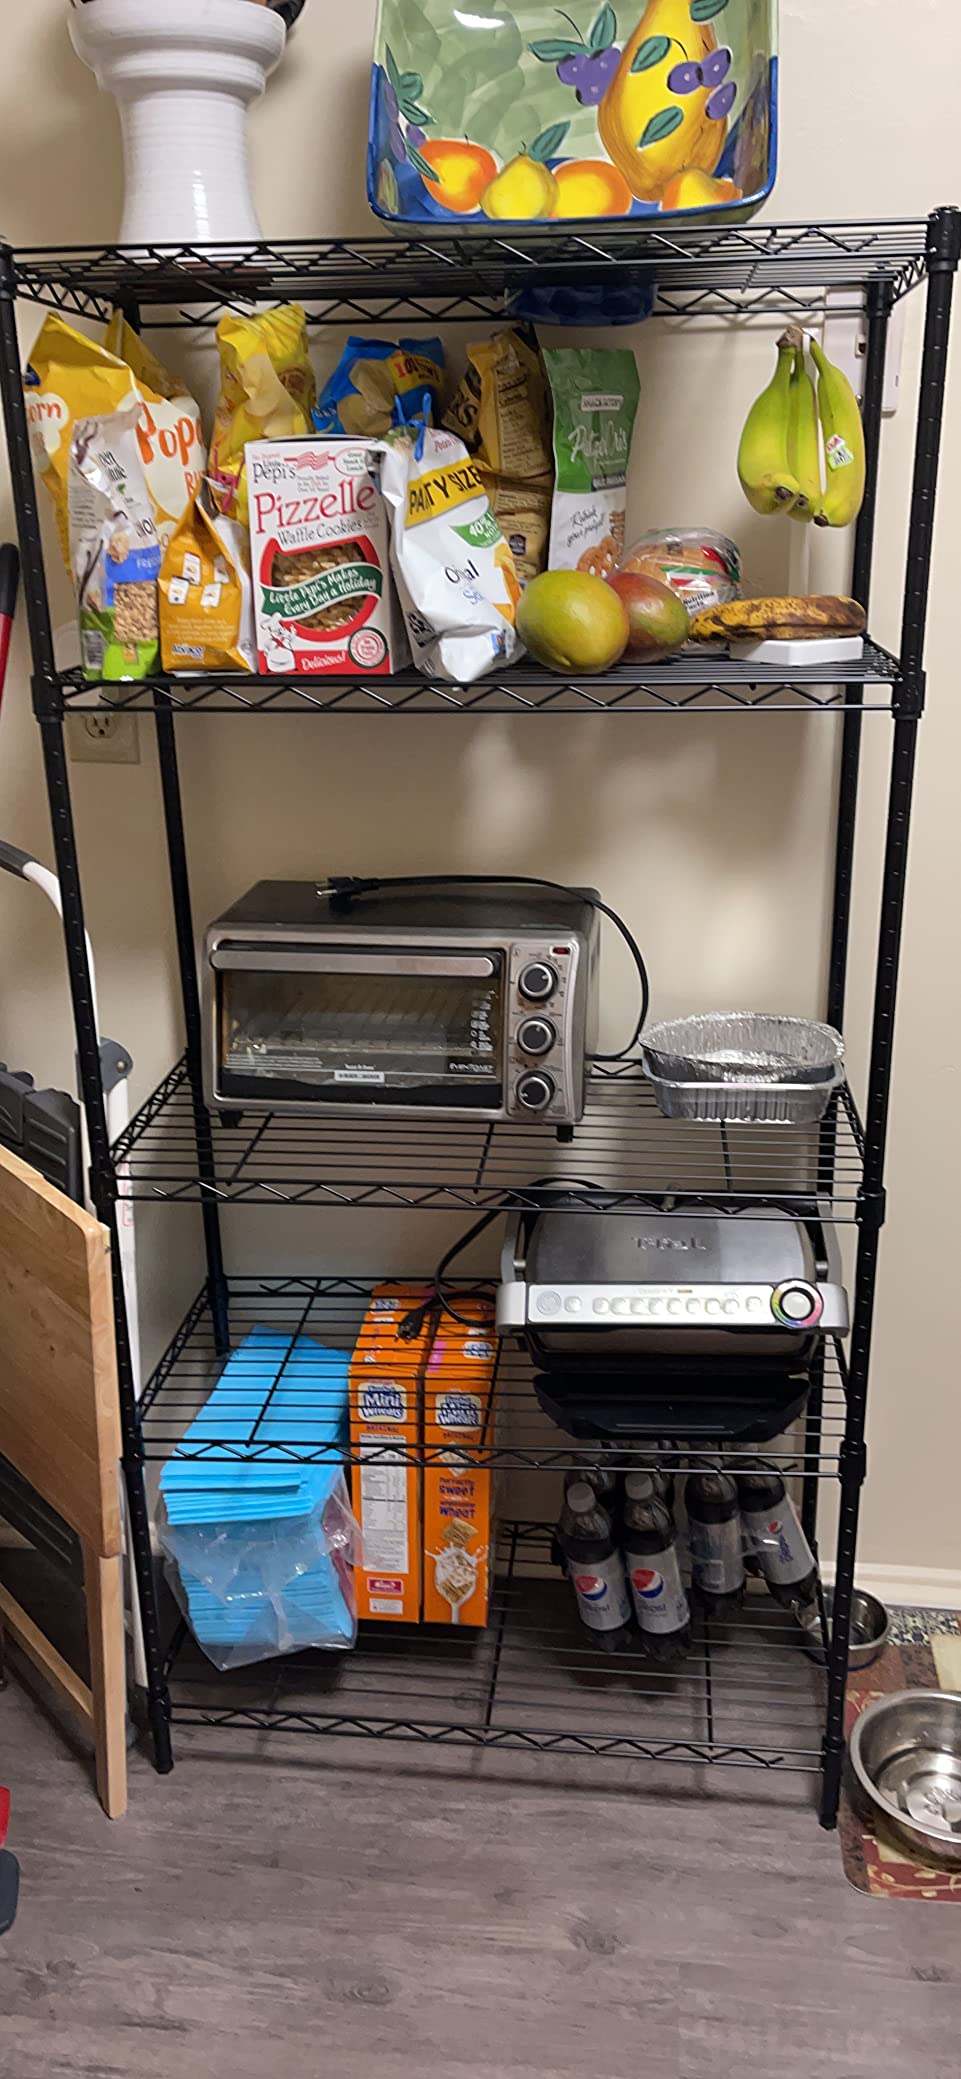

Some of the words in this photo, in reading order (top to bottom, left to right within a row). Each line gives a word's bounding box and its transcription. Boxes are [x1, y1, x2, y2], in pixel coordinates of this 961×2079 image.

[449, 464, 483, 492] SIZE
[253, 476, 377, 535] Pizzelle
[277, 526, 316, 547] Waffle
[316, 517, 363, 540] Cookies
[327, 568, 359, 584] Makes
[283, 600, 311, 616] Every
[309, 590, 331, 606] Day
[338, 575, 377, 595] Holiday
[364, 1392, 402, 1407] Mini
[439, 1485, 475, 1497] sweet
